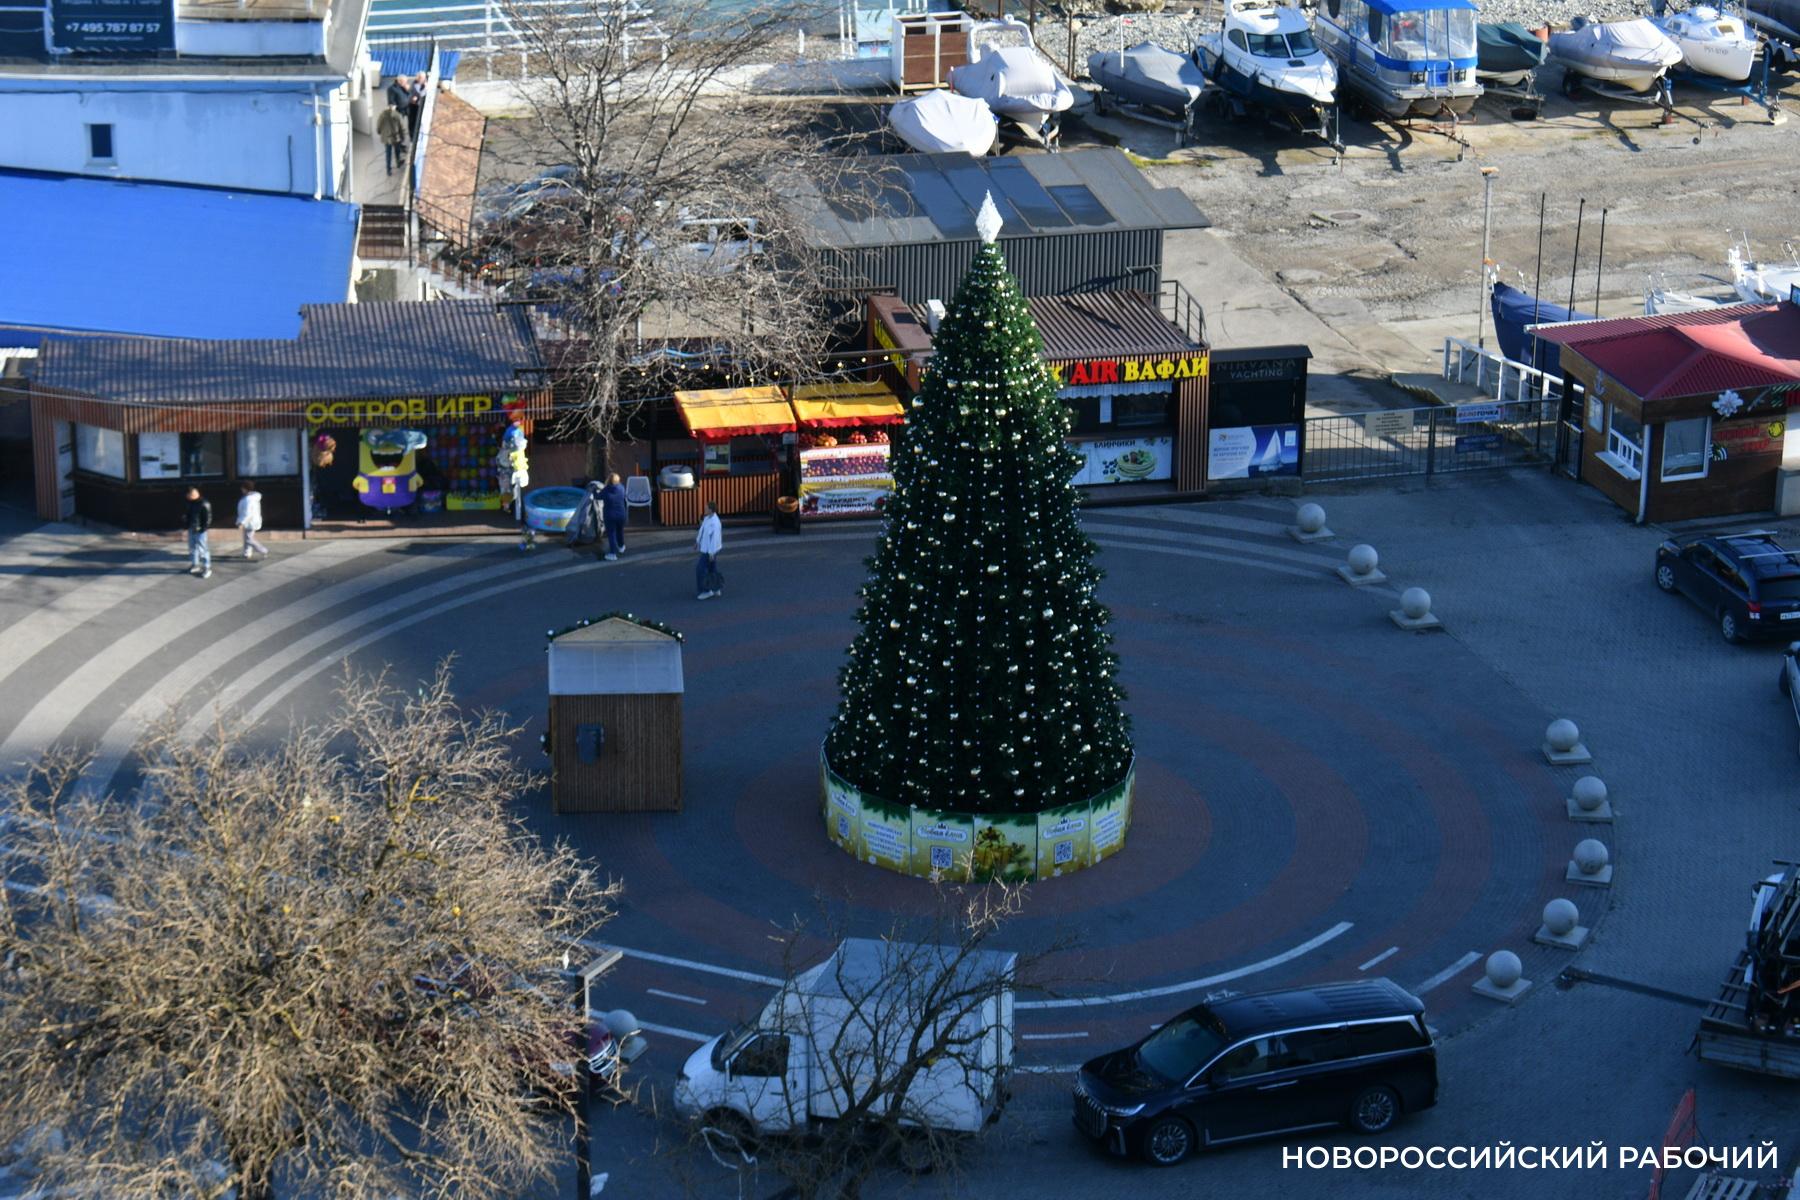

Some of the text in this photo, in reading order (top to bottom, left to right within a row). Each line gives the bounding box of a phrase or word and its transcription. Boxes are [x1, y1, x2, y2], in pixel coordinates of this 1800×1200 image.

[65, 23, 160, 32] +7 495 787 87 57
[1070, 360, 1118, 385] AIR
[1124, 357, 1208, 382] ВАФЛИ
[1230, 368, 1283, 379] YACHTING
[305, 396, 492, 424] ОСТРОВ ИГР
[1094, 439, 1136, 449] БЛИНЧИКИ
